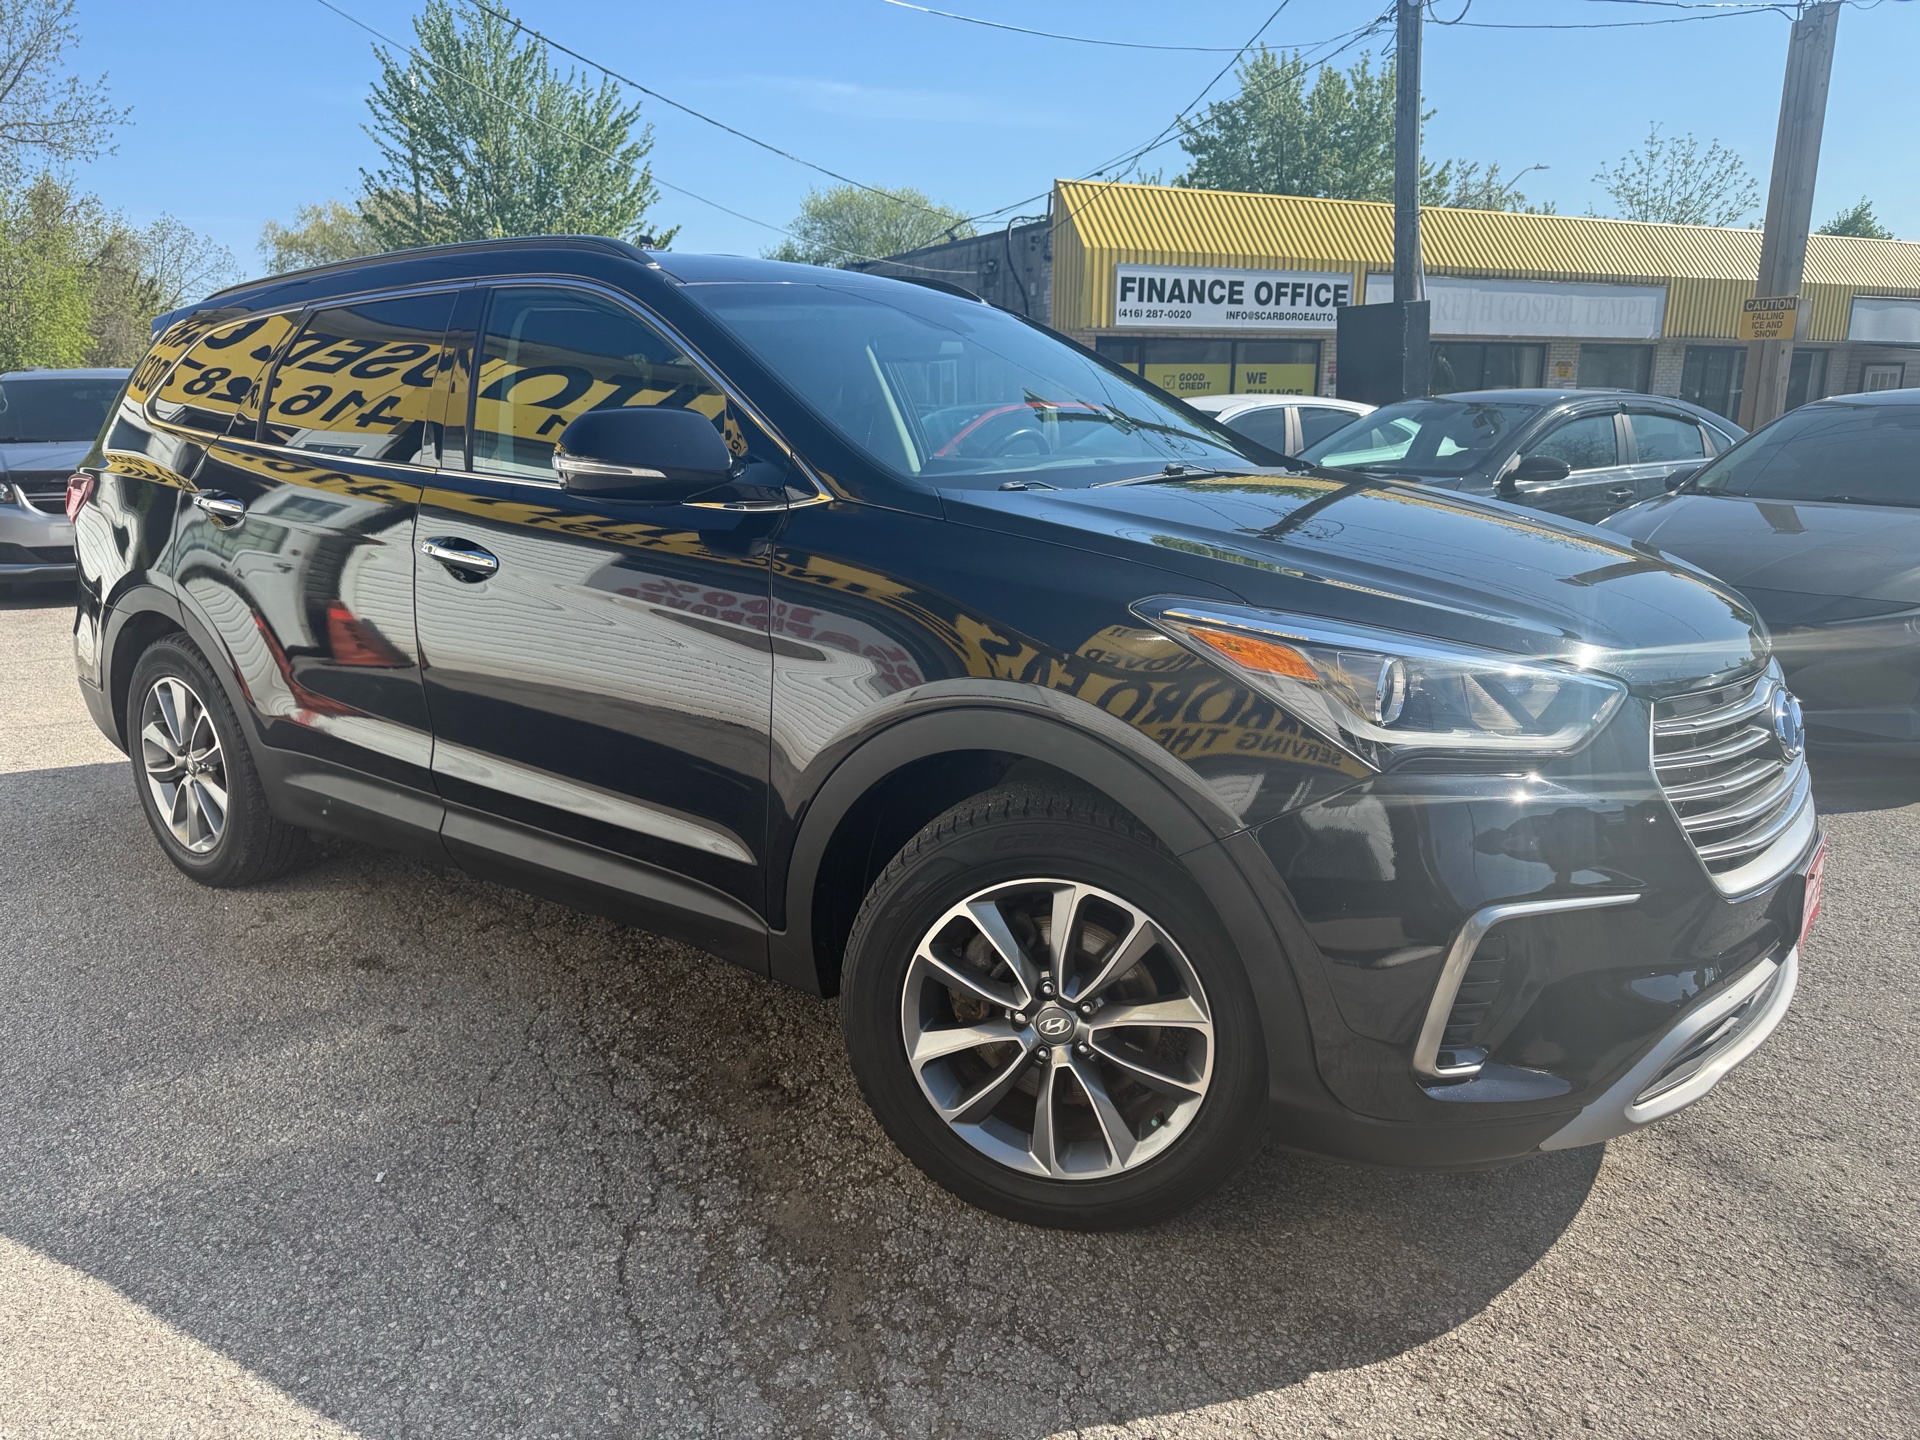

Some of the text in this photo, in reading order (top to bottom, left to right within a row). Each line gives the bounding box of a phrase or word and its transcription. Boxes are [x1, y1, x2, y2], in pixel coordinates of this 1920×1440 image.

[1119, 276, 1349, 308] FINANCE OFFICE
[1746, 299, 1794, 310] CAUTION
[1118, 308, 1192, 319] (416) 287-0020
[1226, 311, 1338, 322] INFO@SCARBOROEAUTO.
[1752, 312, 1784, 320] FALLING
[1751, 321, 1782, 329] ICE AND
[1754, 330, 1778, 338] SNOW
[1179, 373, 1206, 381] GOOD
[1246, 372, 1268, 384] WE
[1178, 381, 1212, 390] CREDIT
